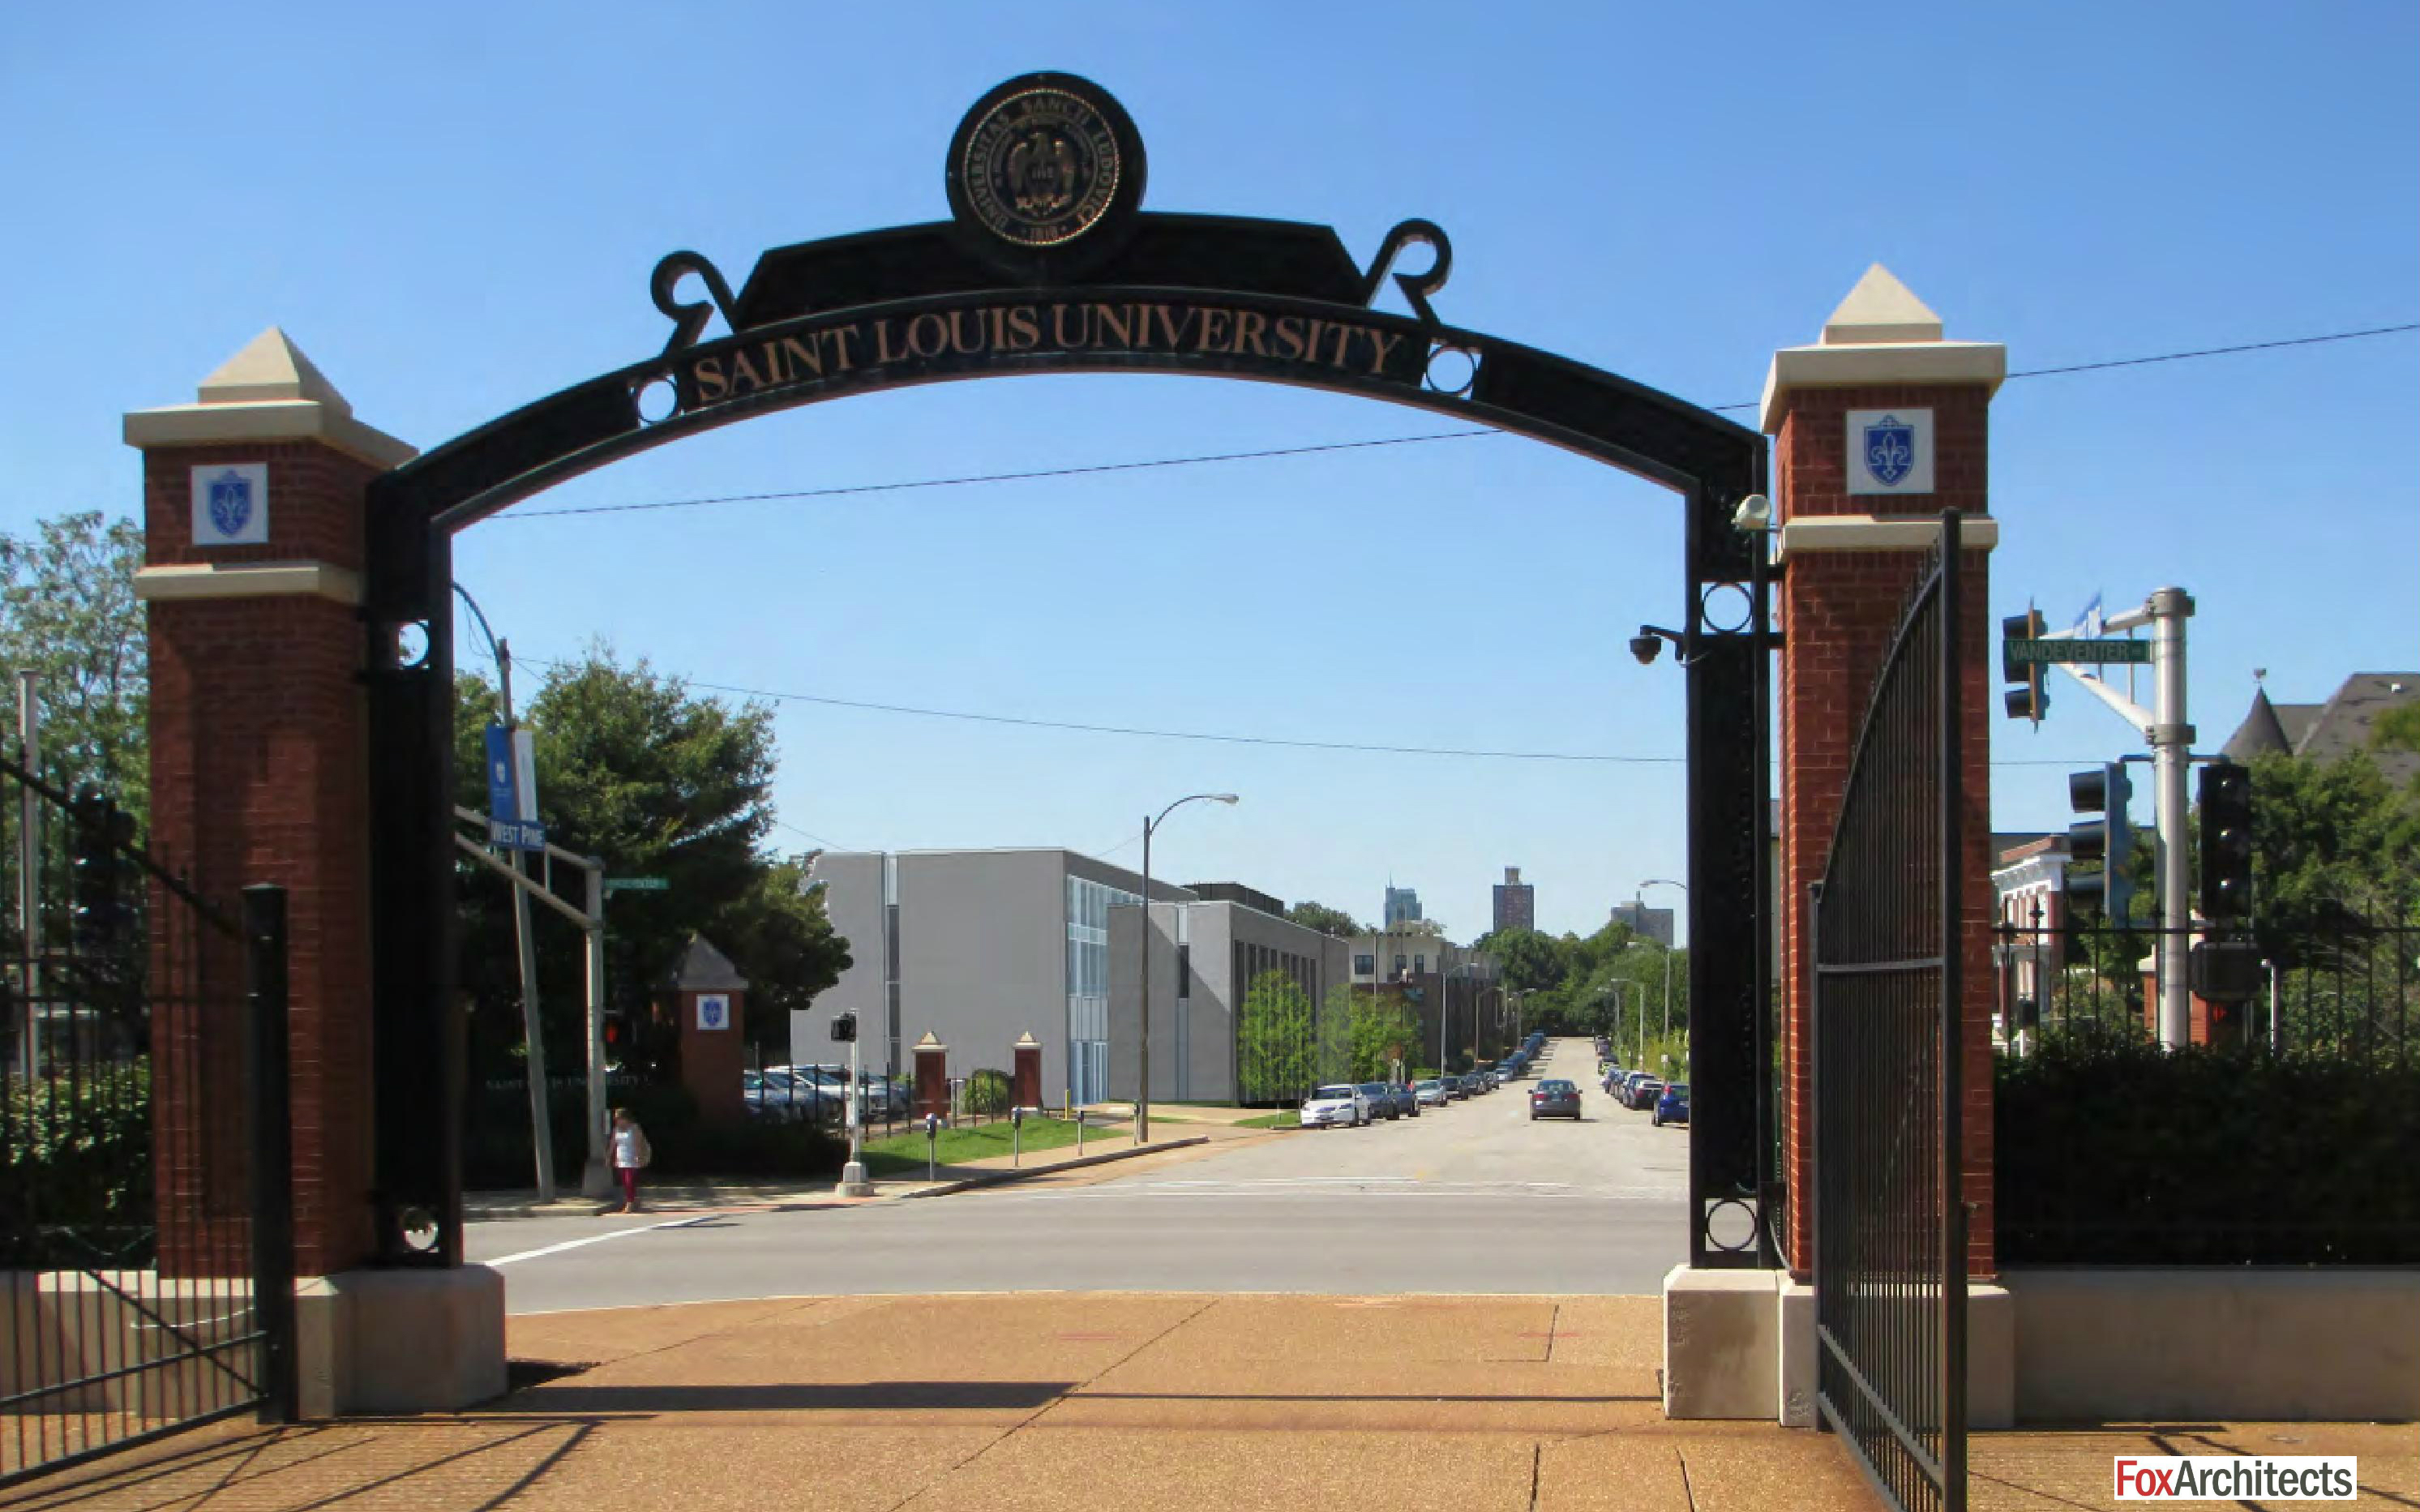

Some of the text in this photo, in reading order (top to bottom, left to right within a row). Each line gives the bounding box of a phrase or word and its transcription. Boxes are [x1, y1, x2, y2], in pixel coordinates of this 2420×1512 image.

[693, 304, 1403, 401] SAINT LOUIS UNIVERSITY
[490, 820, 545, 847] WEST PINE
